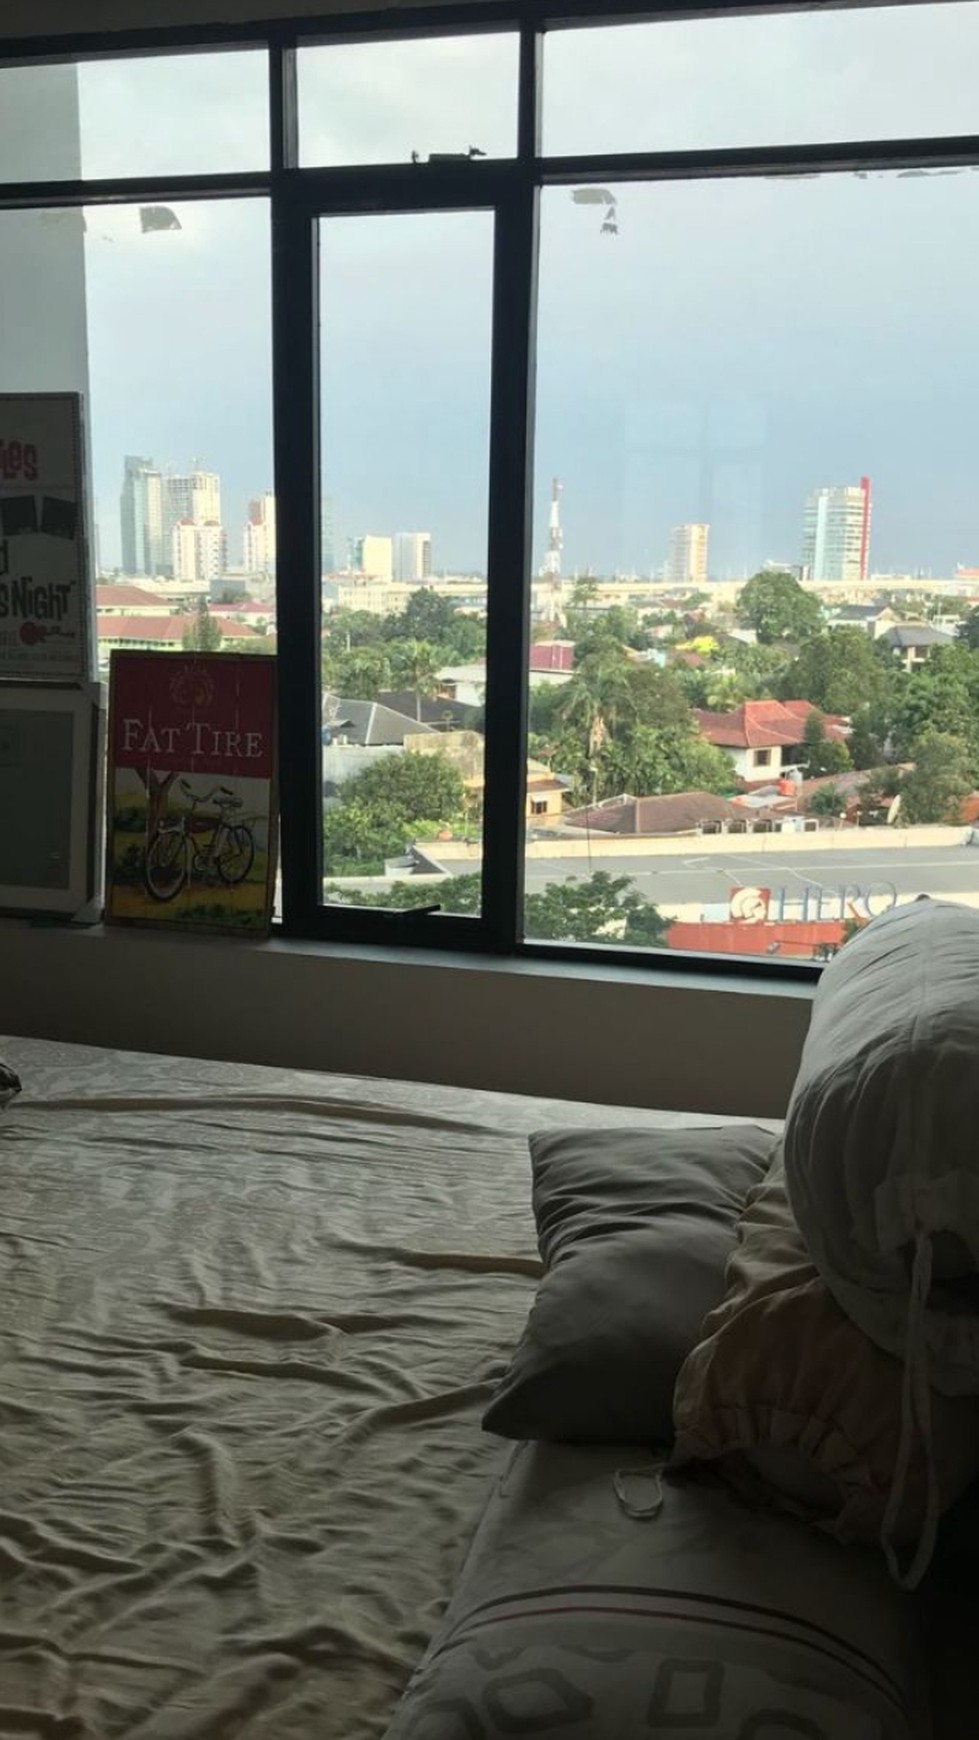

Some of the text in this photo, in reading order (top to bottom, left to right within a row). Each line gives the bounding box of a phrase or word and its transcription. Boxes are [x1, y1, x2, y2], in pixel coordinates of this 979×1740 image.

[121, 718, 264, 758] FAT TIRE
[777, 881, 898, 922] HERO
